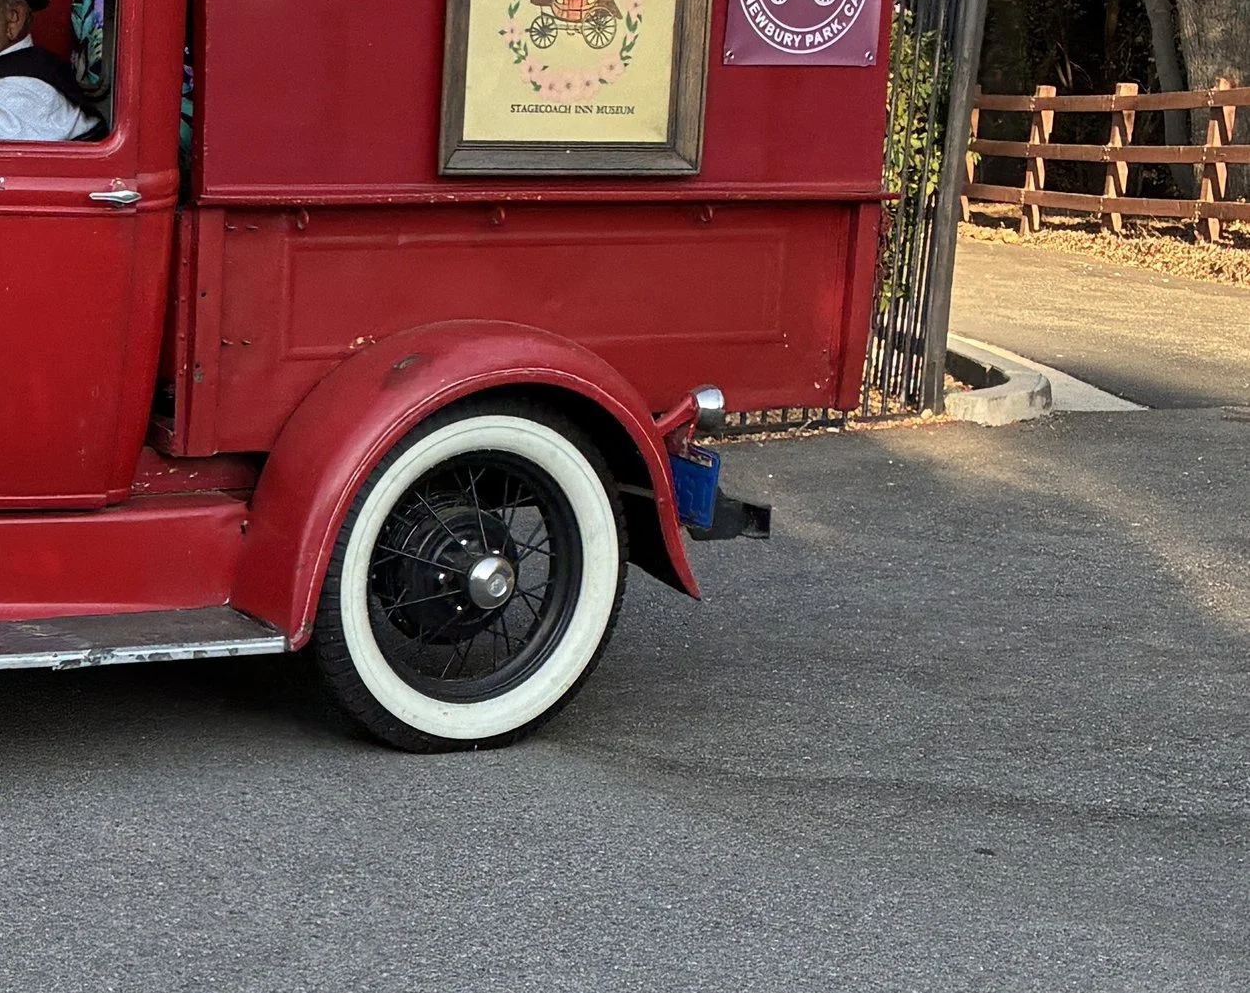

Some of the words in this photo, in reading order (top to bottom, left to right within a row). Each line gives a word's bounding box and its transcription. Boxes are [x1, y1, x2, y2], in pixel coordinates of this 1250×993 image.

[805, 18, 847, 47] PARK,
[510, 104, 571, 114] STAGECOACH
[574, 105, 593, 114] INN
[596, 106, 635, 115] MUSEUM
